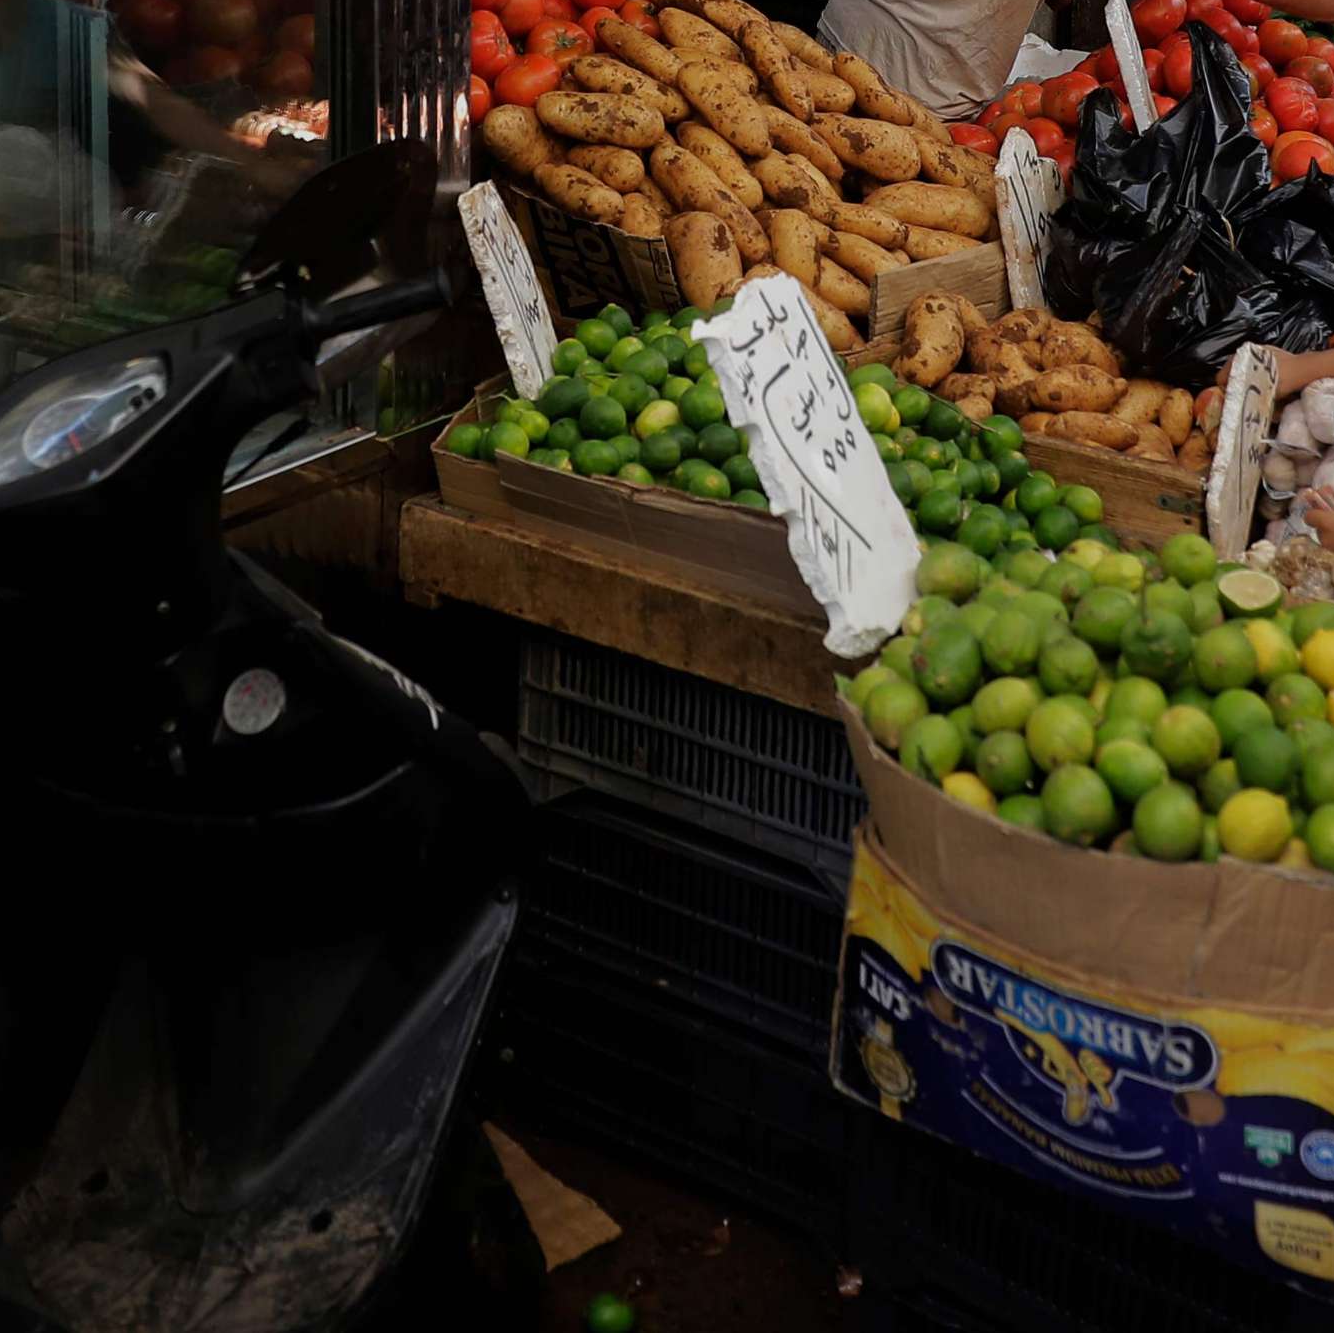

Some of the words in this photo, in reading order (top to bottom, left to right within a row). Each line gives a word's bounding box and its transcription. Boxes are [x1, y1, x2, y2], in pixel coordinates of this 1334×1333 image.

[730, 288, 789, 357] بلدي
[866, 972, 912, 1022] CAT
[946, 949, 1196, 1076] SABROSTAR
